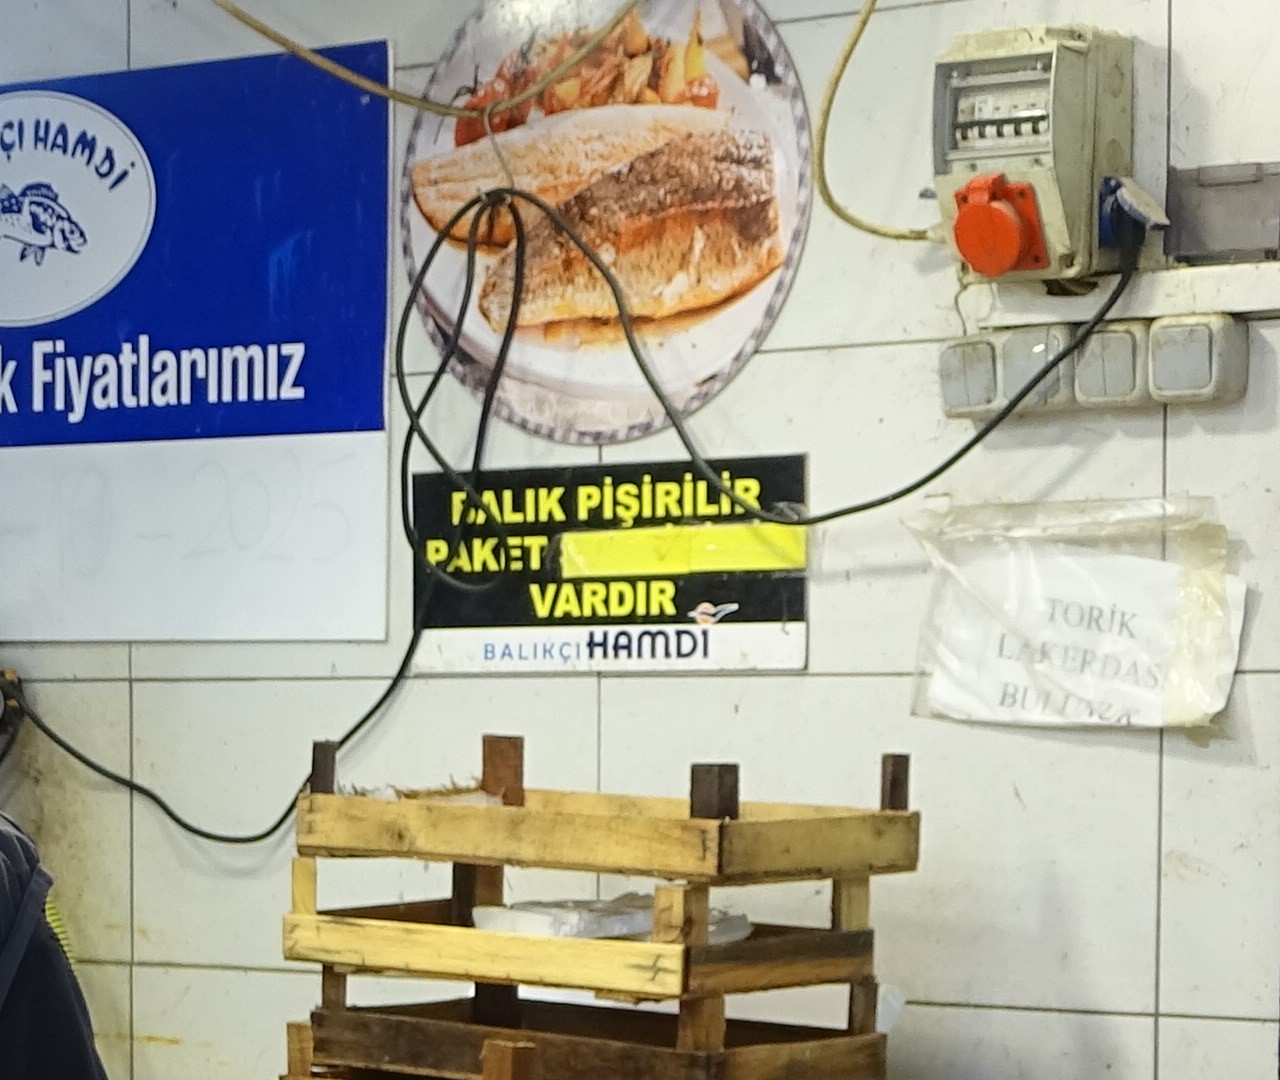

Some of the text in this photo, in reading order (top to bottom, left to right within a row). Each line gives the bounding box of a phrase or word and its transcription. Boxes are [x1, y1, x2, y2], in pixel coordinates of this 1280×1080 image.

[33, 117, 136, 193] HAMDİ
[32, 334, 306, 423] Fiyatlarımız
[425, 534, 549, 573] PAKET
[529, 580, 678, 618] VARDIR
[1046, 596, 1138, 639] TORİK
[483, 641, 582, 664] BALIKÇI
